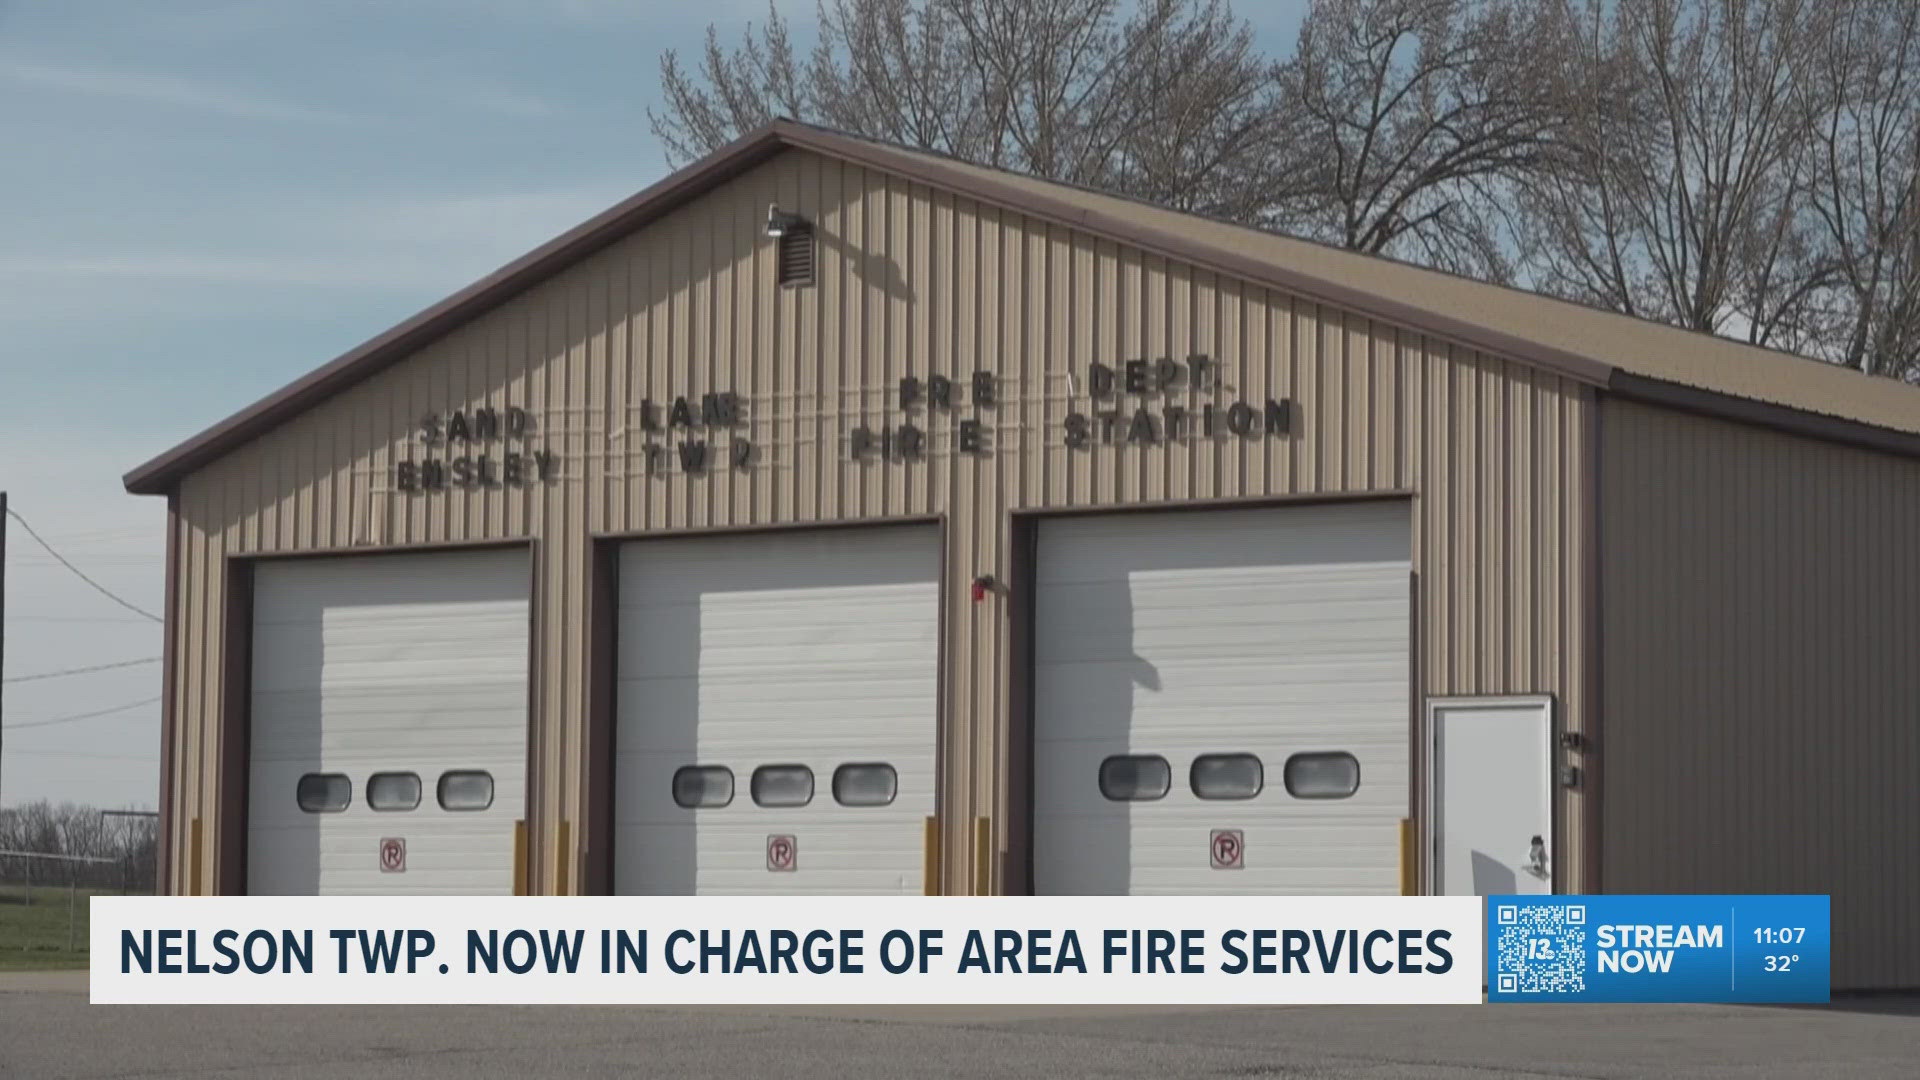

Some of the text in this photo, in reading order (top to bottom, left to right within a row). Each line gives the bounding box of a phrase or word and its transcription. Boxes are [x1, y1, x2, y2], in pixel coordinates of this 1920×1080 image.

[397, 450, 551, 491] ENSLEY
[1064, 398, 1291, 449] STATION
[420, 406, 526, 443] SAND
